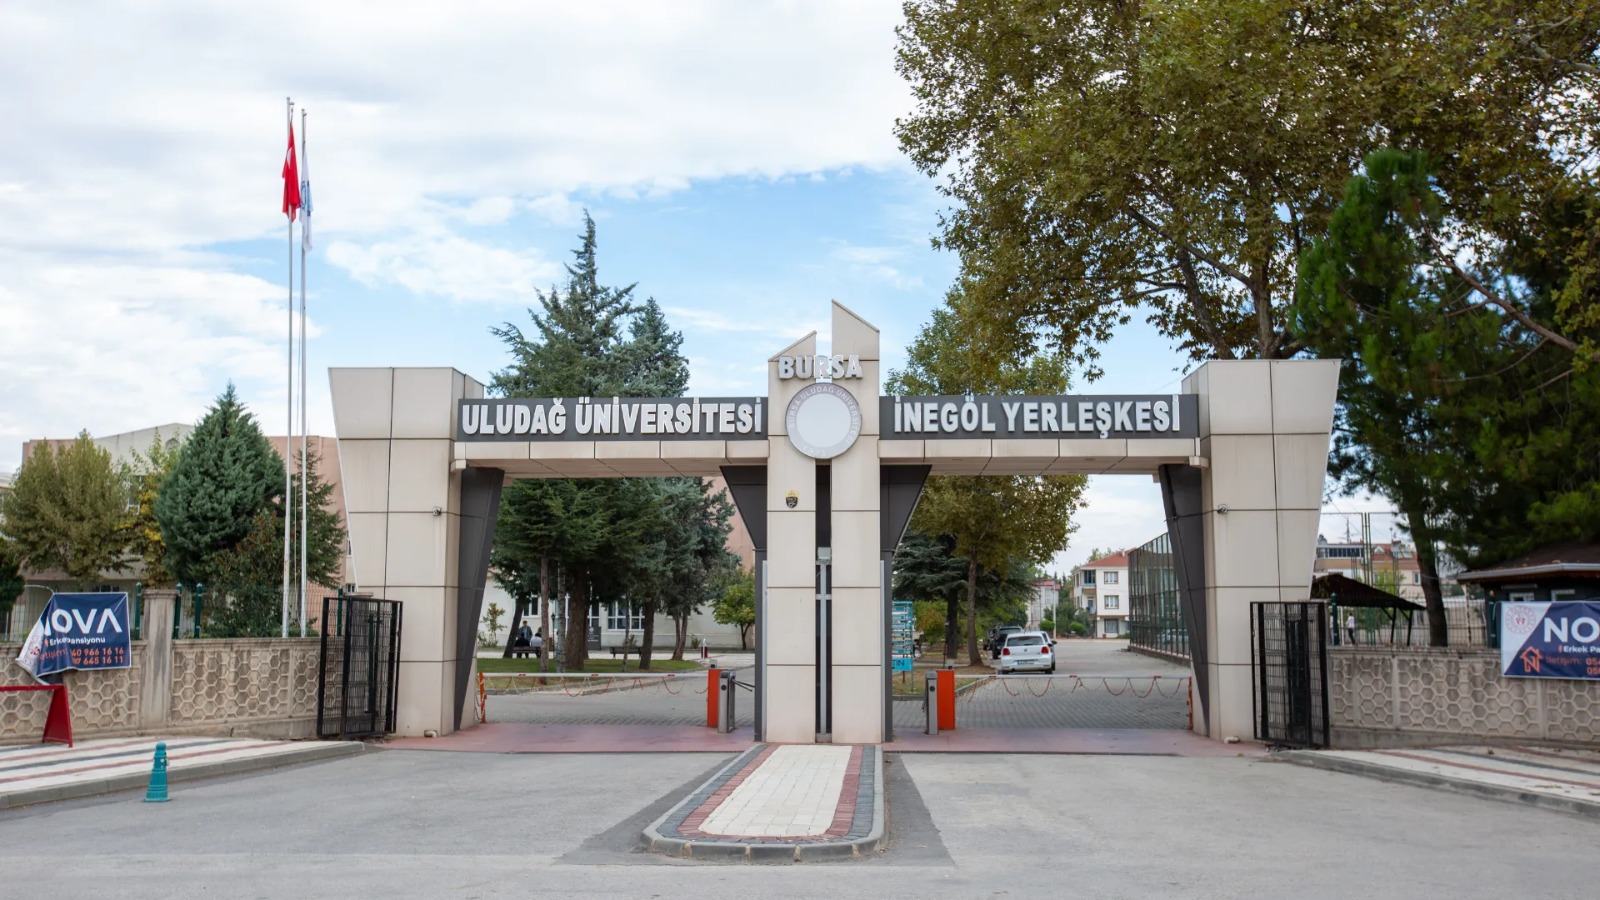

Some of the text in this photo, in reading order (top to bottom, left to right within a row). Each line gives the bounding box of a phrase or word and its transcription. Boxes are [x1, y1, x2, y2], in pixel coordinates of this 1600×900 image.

[778, 355, 863, 380] BURSA
[462, 396, 762, 434] ULUDAĞ ÜNİVERSİTESİ
[894, 394, 1180, 439] İNEGÖL YERLEŞKESİ
[102, 647, 112, 656] 16
[114, 647, 124, 655] 16
[102, 655, 112, 664] 16
